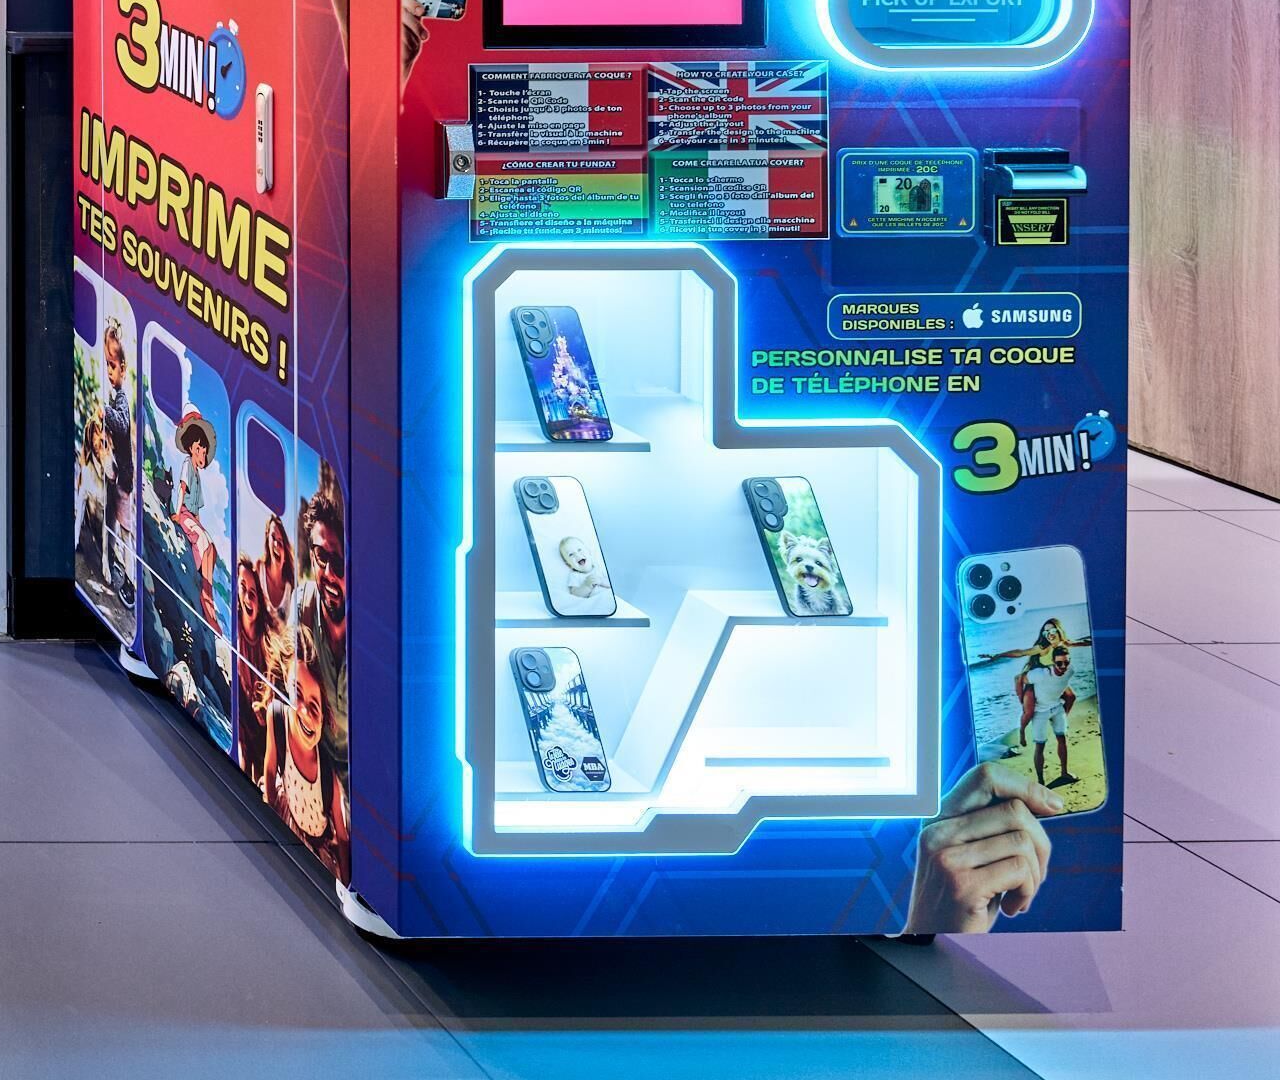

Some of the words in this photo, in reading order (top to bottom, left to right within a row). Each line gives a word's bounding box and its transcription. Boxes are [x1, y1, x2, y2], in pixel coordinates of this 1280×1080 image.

[158, 22, 205, 107] MIN
[916, 165, 938, 173] 20€
[895, 177, 912, 190] 20
[79, 109, 292, 311] IMPRIME
[879, 205, 890, 213] 20
[1011, 224, 1054, 232] INSERT
[77, 194, 117, 252] TES
[121, 231, 271, 369] SOUVENIRS
[276, 337, 289, 383] !
[842, 303, 920, 315] MARQUES
[991, 308, 1072, 323] SAMSUNG
[842, 318, 946, 331] DISPONIBLES
[751, 348, 943, 367] PERSONNALISE
[950, 348, 982, 365] TA
[989, 346, 1075, 365] COQUE
[751, 377, 784, 394] DE
[791, 372, 940, 394] TÉLÉPHONE
[947, 375, 981, 392] EN
[951, 418, 1020, 494] 3
[1017, 433, 1077, 478] MIN
